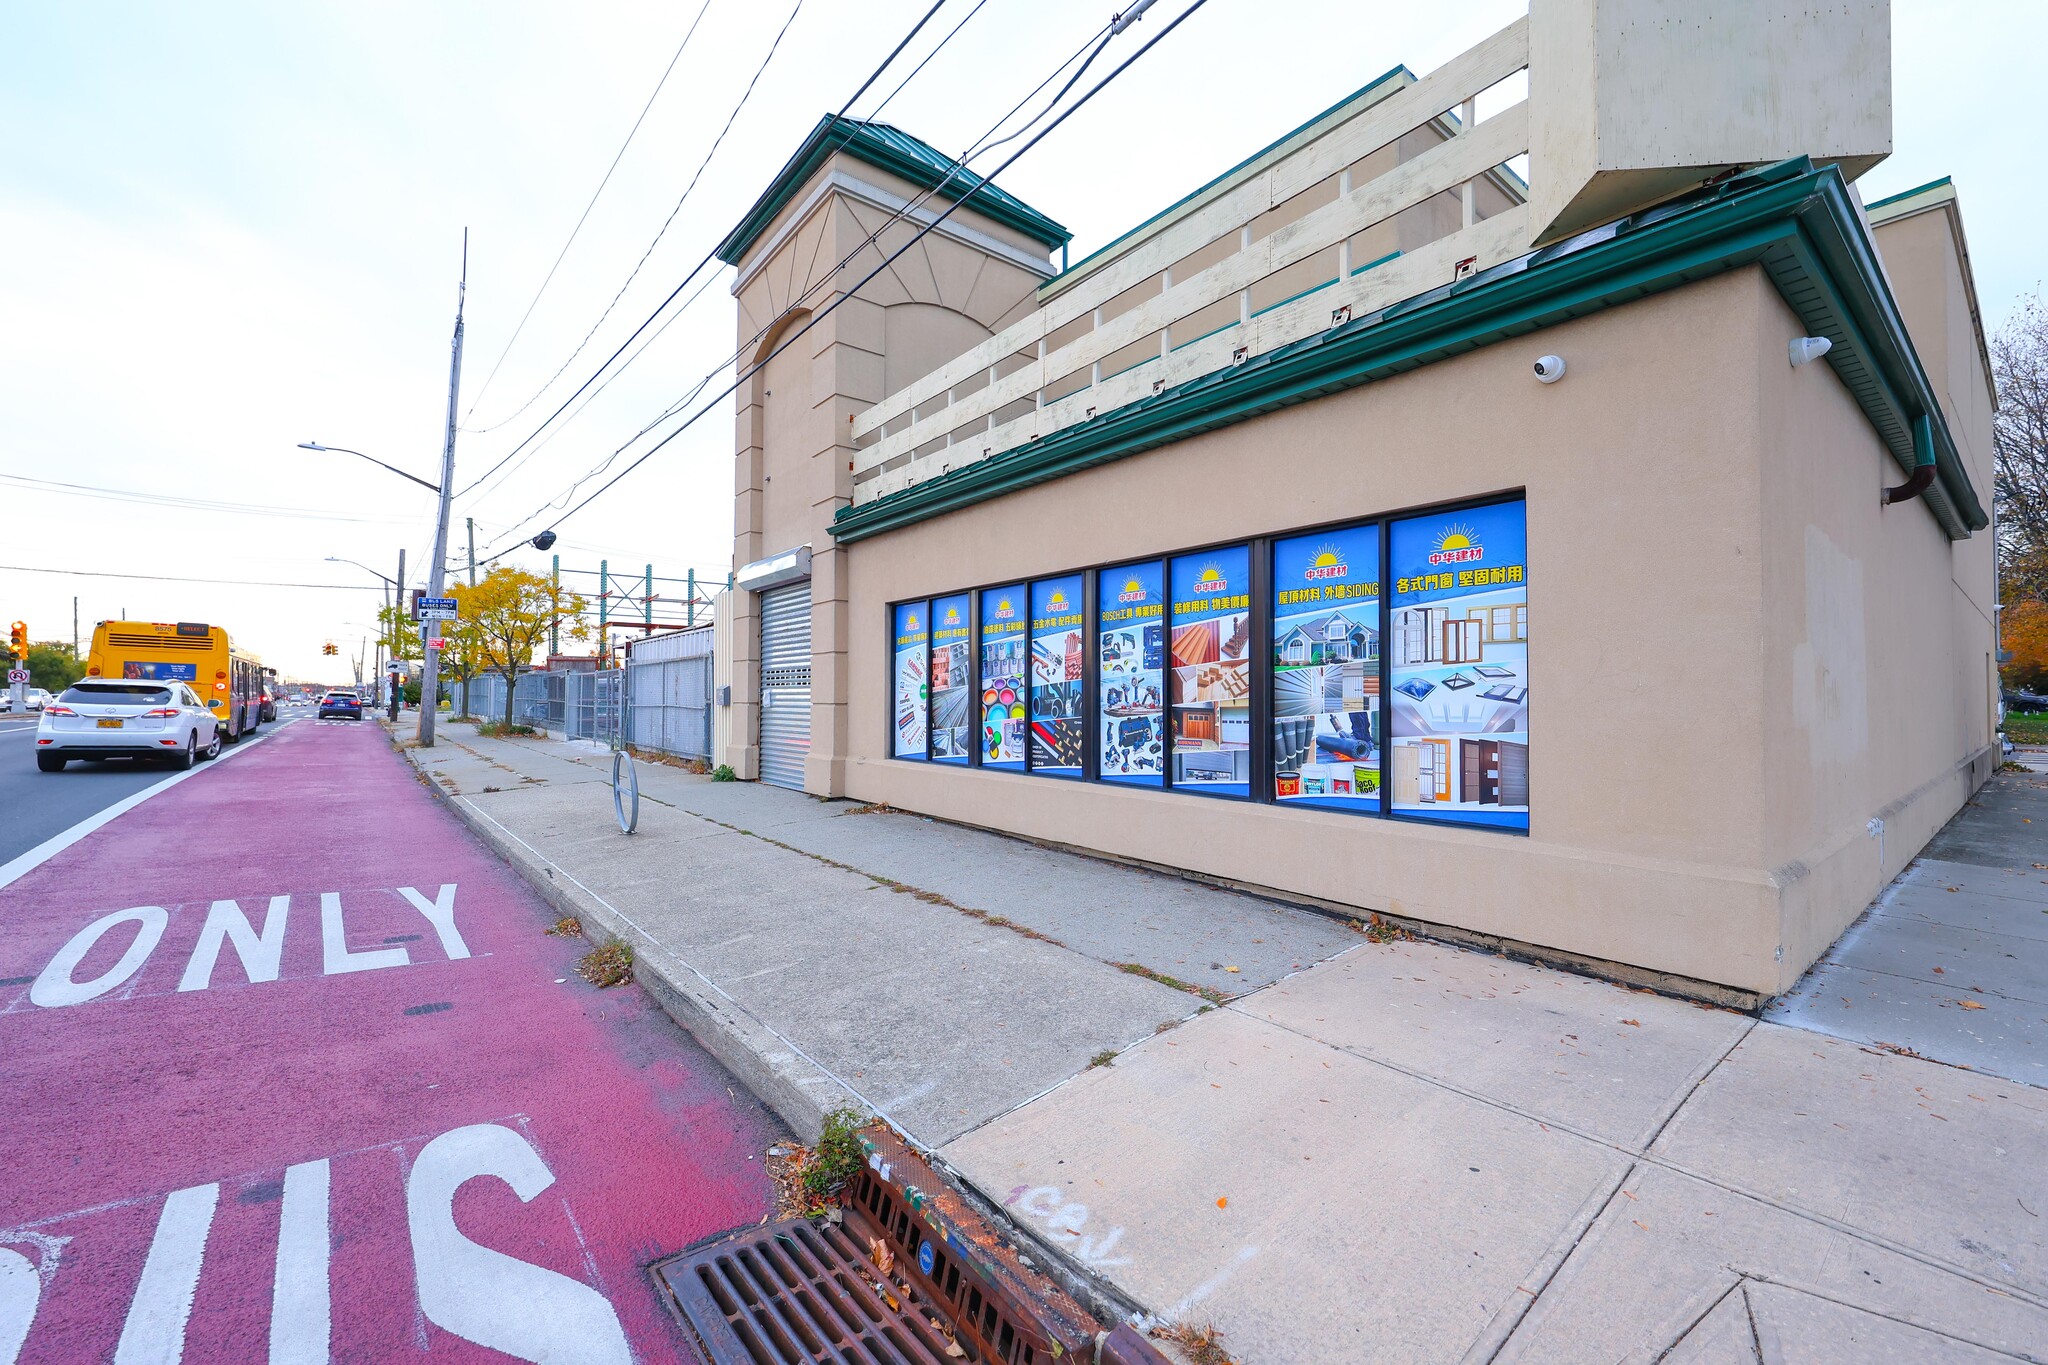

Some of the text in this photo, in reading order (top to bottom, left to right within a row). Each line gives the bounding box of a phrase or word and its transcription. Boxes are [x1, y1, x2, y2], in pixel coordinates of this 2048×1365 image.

[1428, 547, 1484, 566] 中华建材
[1305, 564, 1348, 580] 中华建材
[1396, 565, 1524, 594] 各式門窗 堅固耐用
[1193, 580, 1228, 593] 中华建材
[1118, 591, 1146, 603] 中华建材
[1278, 587, 1321, 605] 屋頂材料
[1046, 602, 1069, 613] 中华建材
[1174, 600, 1209, 615] 裝修用料
[29, 883, 471, 1008] ONLY
